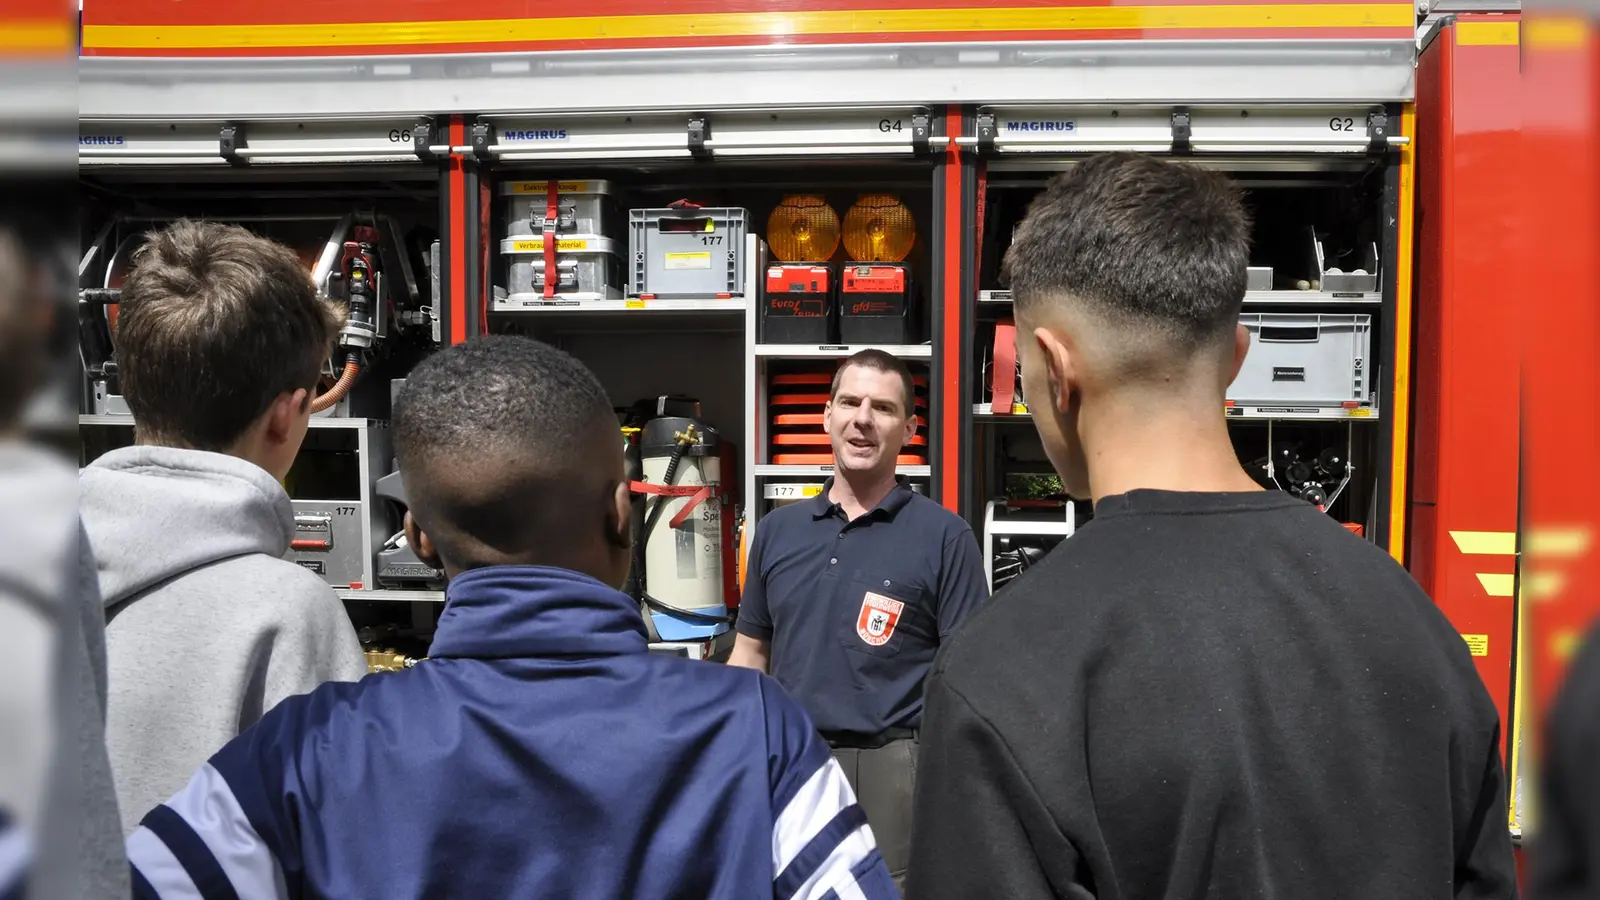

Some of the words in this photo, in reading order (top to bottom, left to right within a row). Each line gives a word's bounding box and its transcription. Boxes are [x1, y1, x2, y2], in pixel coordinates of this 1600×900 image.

[879, 119, 903, 133] G4
[1007, 121, 1074, 131] MAGIRUS
[1329, 117, 1354, 131] G2
[388, 128, 411, 143] G6
[505, 130, 567, 141] MAGIRUS
[701, 236, 723, 246] 177
[774, 487, 794, 496] 177
[335, 507, 356, 516] 177
